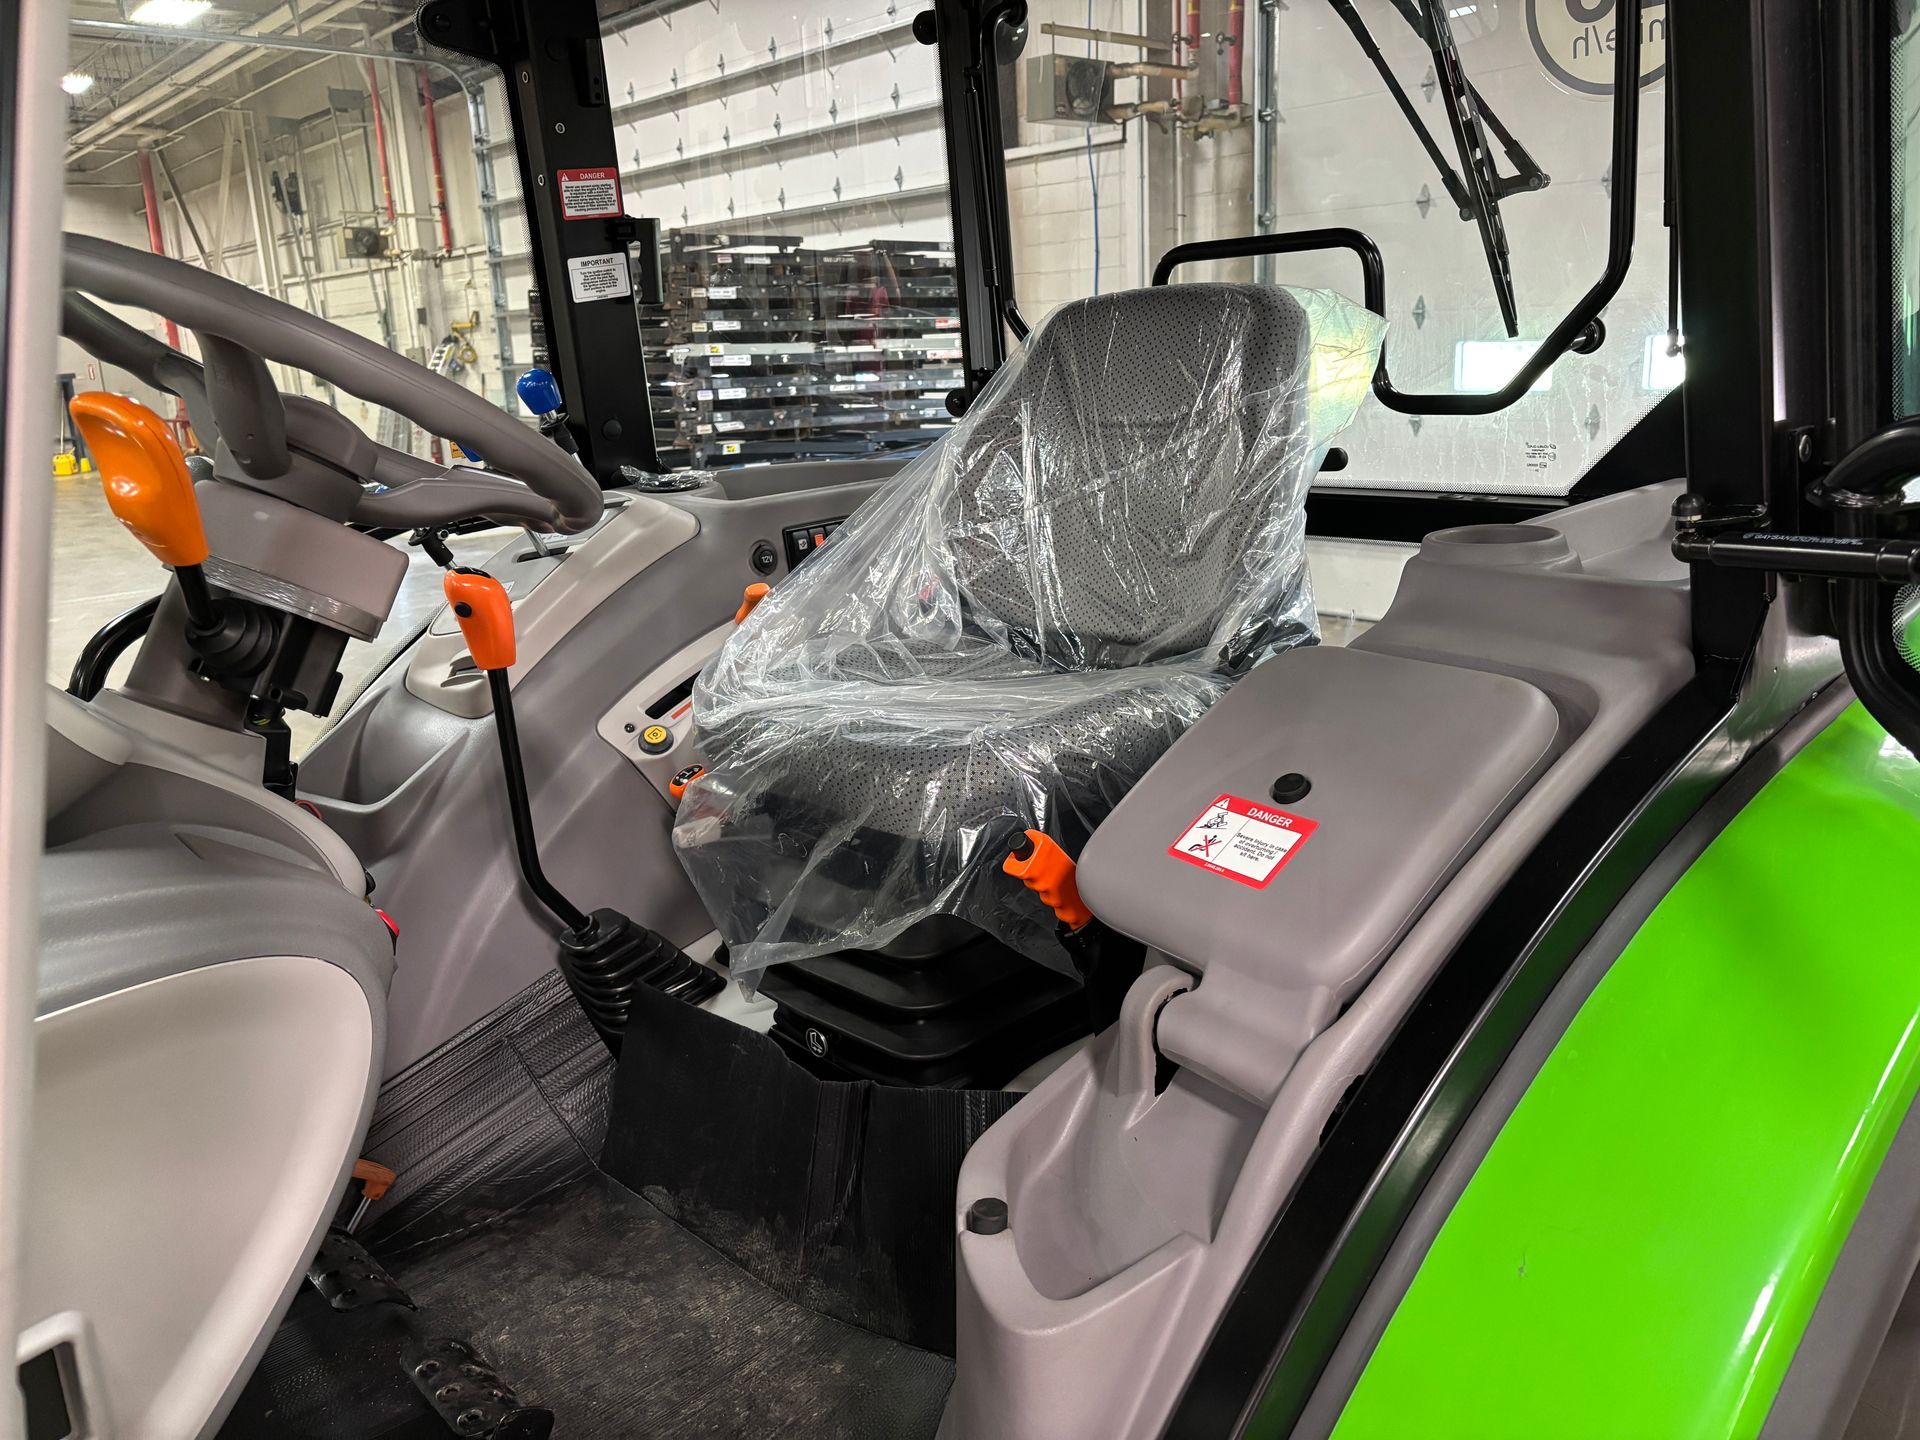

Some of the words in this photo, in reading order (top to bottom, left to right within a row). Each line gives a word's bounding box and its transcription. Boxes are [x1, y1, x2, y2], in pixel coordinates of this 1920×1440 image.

[581, 172, 606, 180] DANGER
[582, 257, 614, 267] IMPORTANT
[761, 555, 773, 564] 12V
[1247, 807, 1293, 828] DANGER
[1236, 832, 1253, 842] Severe
[1253, 838, 1269, 848] injury
[1245, 842, 1274, 855] overturning
